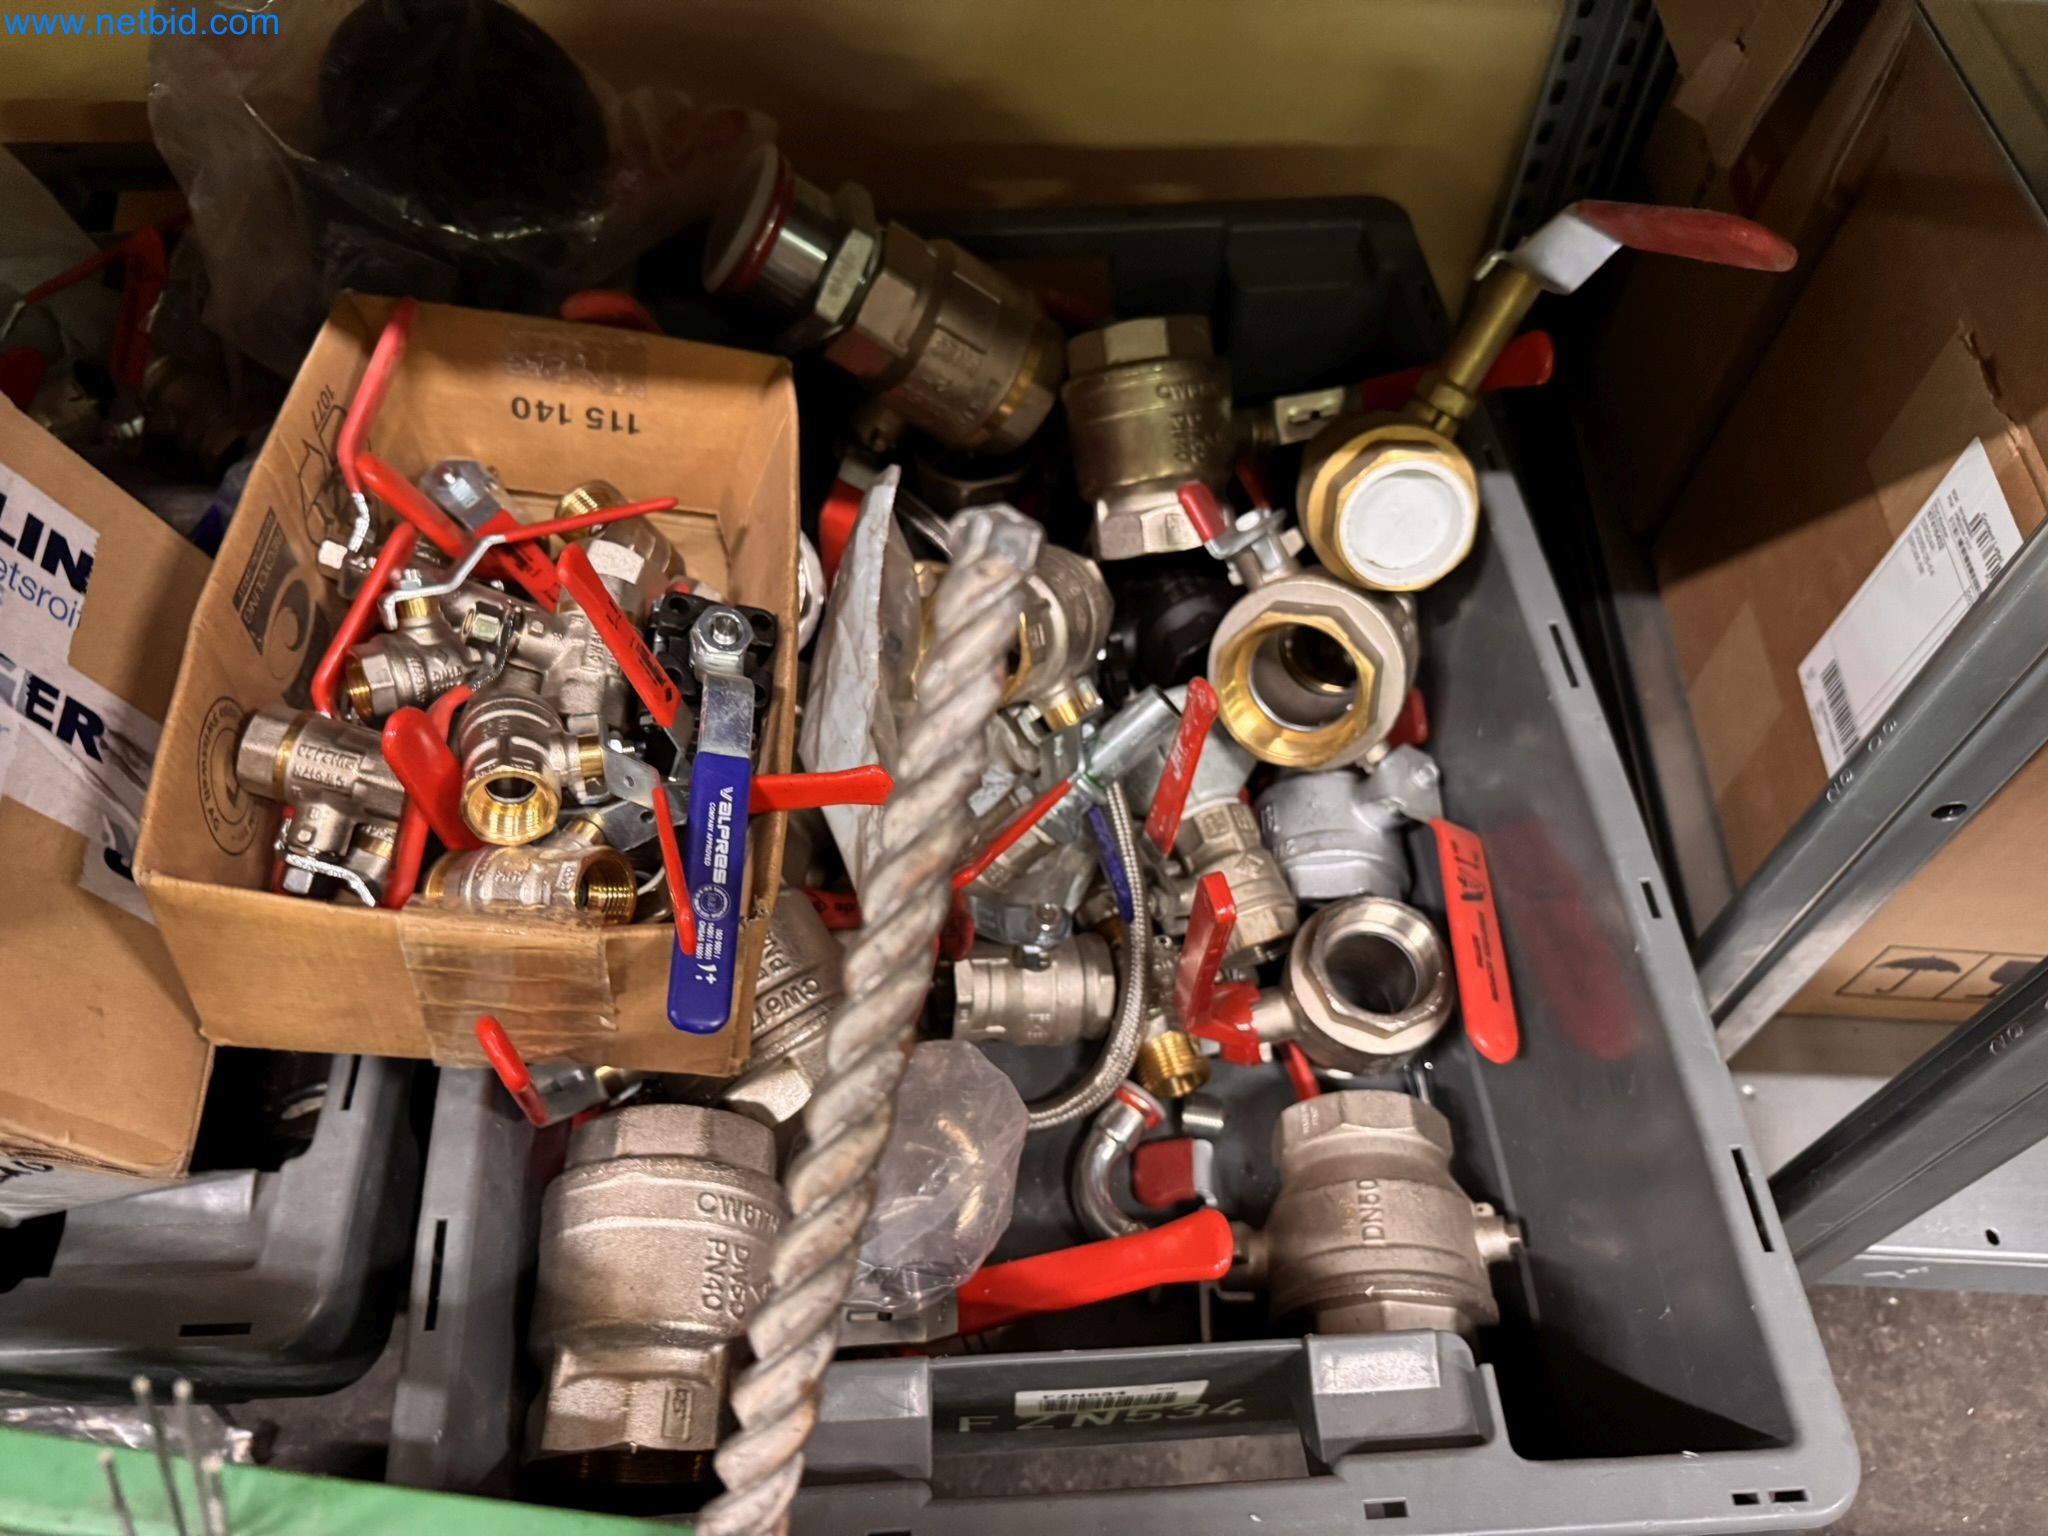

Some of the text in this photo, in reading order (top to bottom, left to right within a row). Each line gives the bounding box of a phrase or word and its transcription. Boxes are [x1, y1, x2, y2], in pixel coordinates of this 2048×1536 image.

[511, 397, 641, 435] 115 140
[1356, 1178, 1385, 1241] DN50
[702, 1238, 728, 1311] PN40
